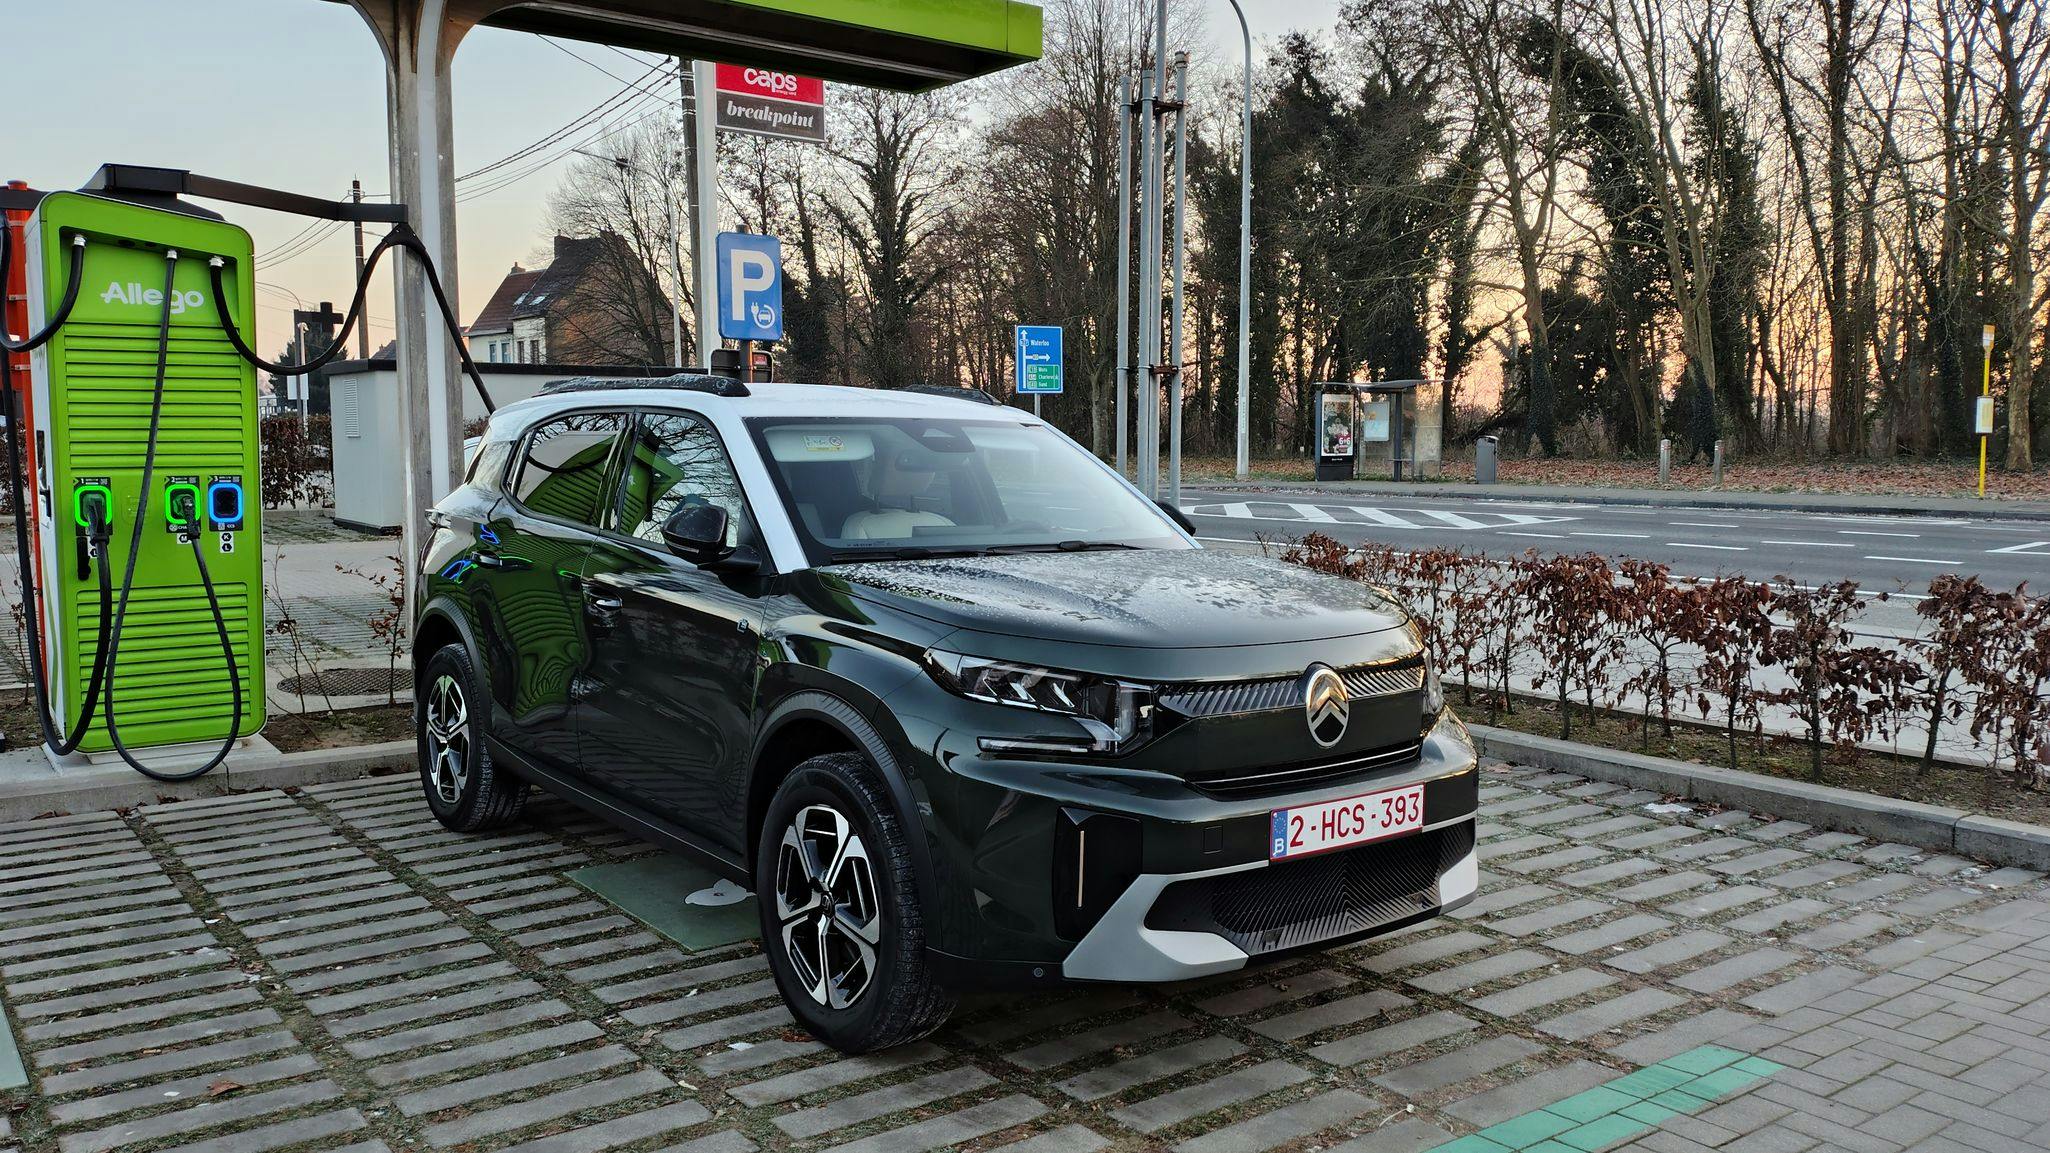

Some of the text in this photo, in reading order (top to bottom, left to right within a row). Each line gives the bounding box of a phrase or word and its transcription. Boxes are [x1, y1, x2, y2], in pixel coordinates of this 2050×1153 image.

[743, 68, 798, 92] caps
[727, 100, 814, 127] breakpoint
[100, 281, 204, 314] Allego
[731, 249, 775, 320] P
[1290, 792, 1420, 848] 2-HCS-393
[1274, 838, 1285, 853] B
